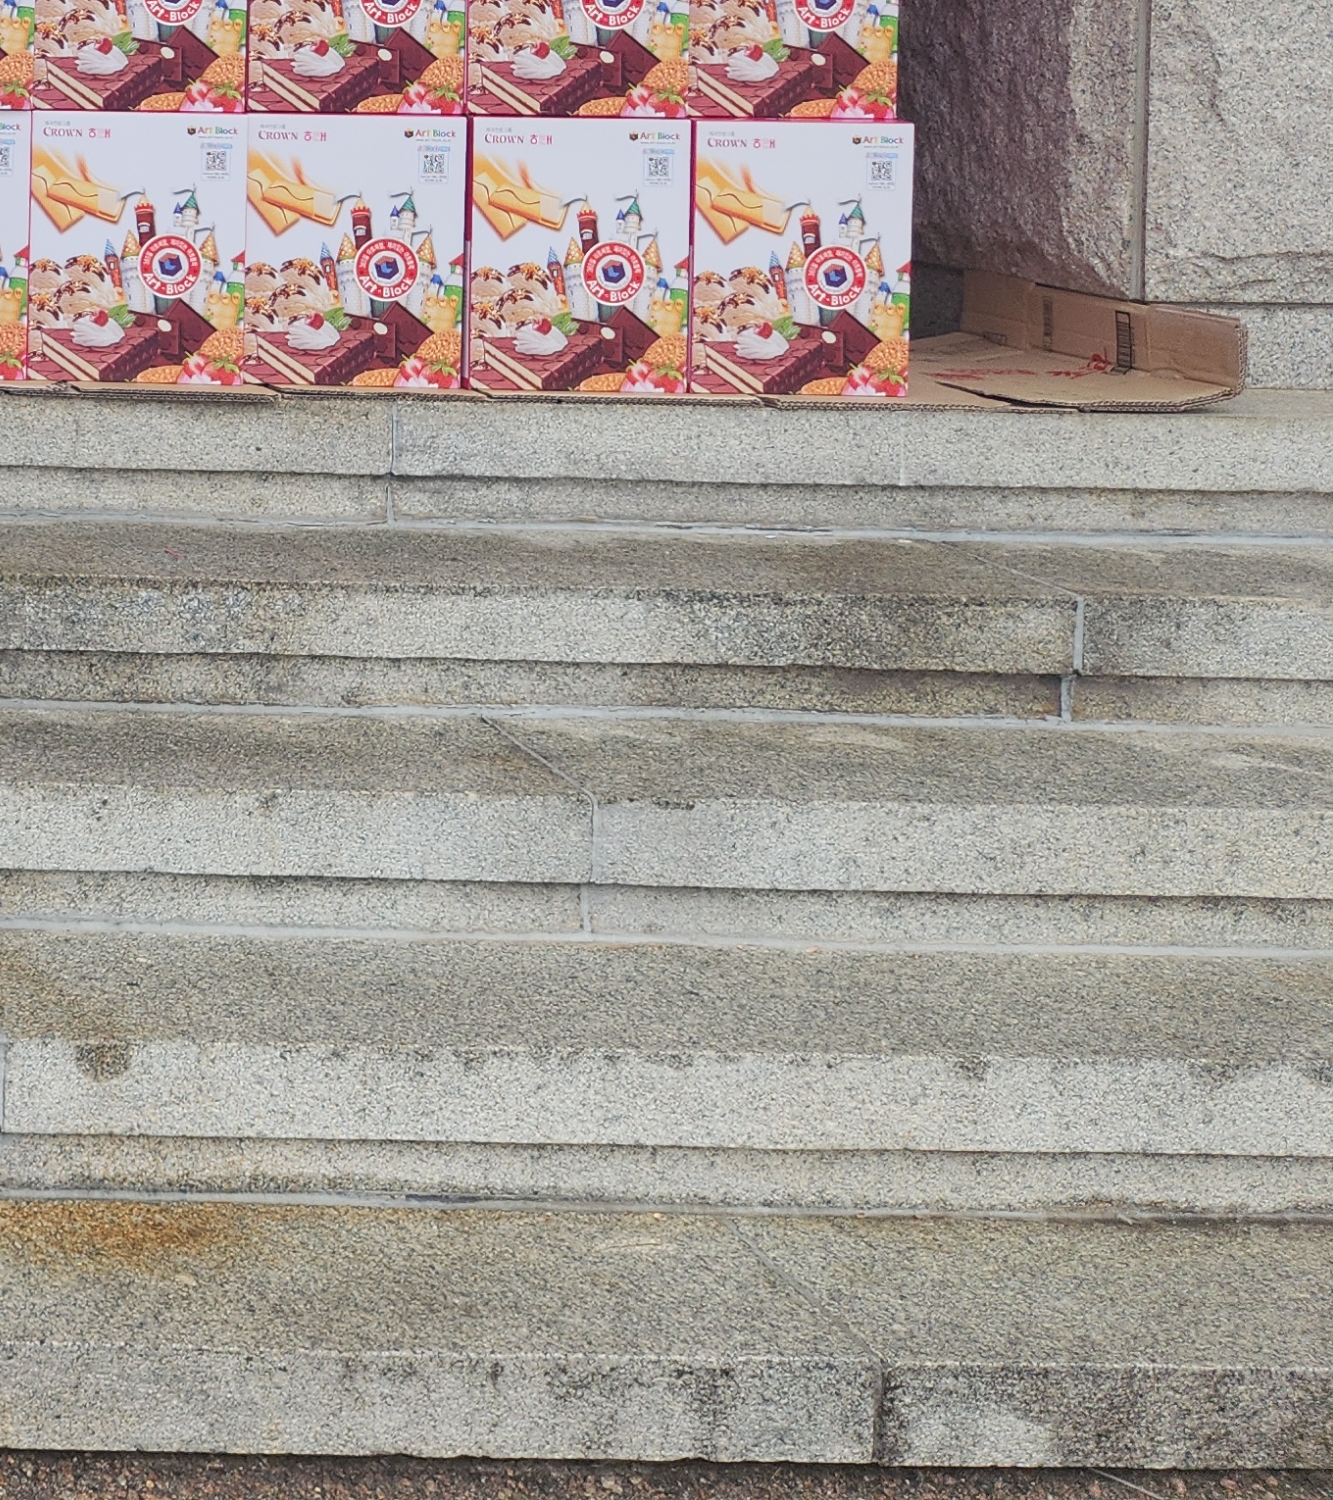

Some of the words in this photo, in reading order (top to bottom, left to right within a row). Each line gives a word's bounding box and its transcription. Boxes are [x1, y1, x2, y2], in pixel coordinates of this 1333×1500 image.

[42, 126, 82, 136] CROWN
[257, 130, 298, 139] CROWN
[414, 128, 430, 137] Art
[432, 129, 456, 137] Block
[639, 131, 655, 139] Art
[657, 131, 680, 139] Block
[484, 133, 524, 143] CROWN
[707, 137, 747, 147] CROWN
